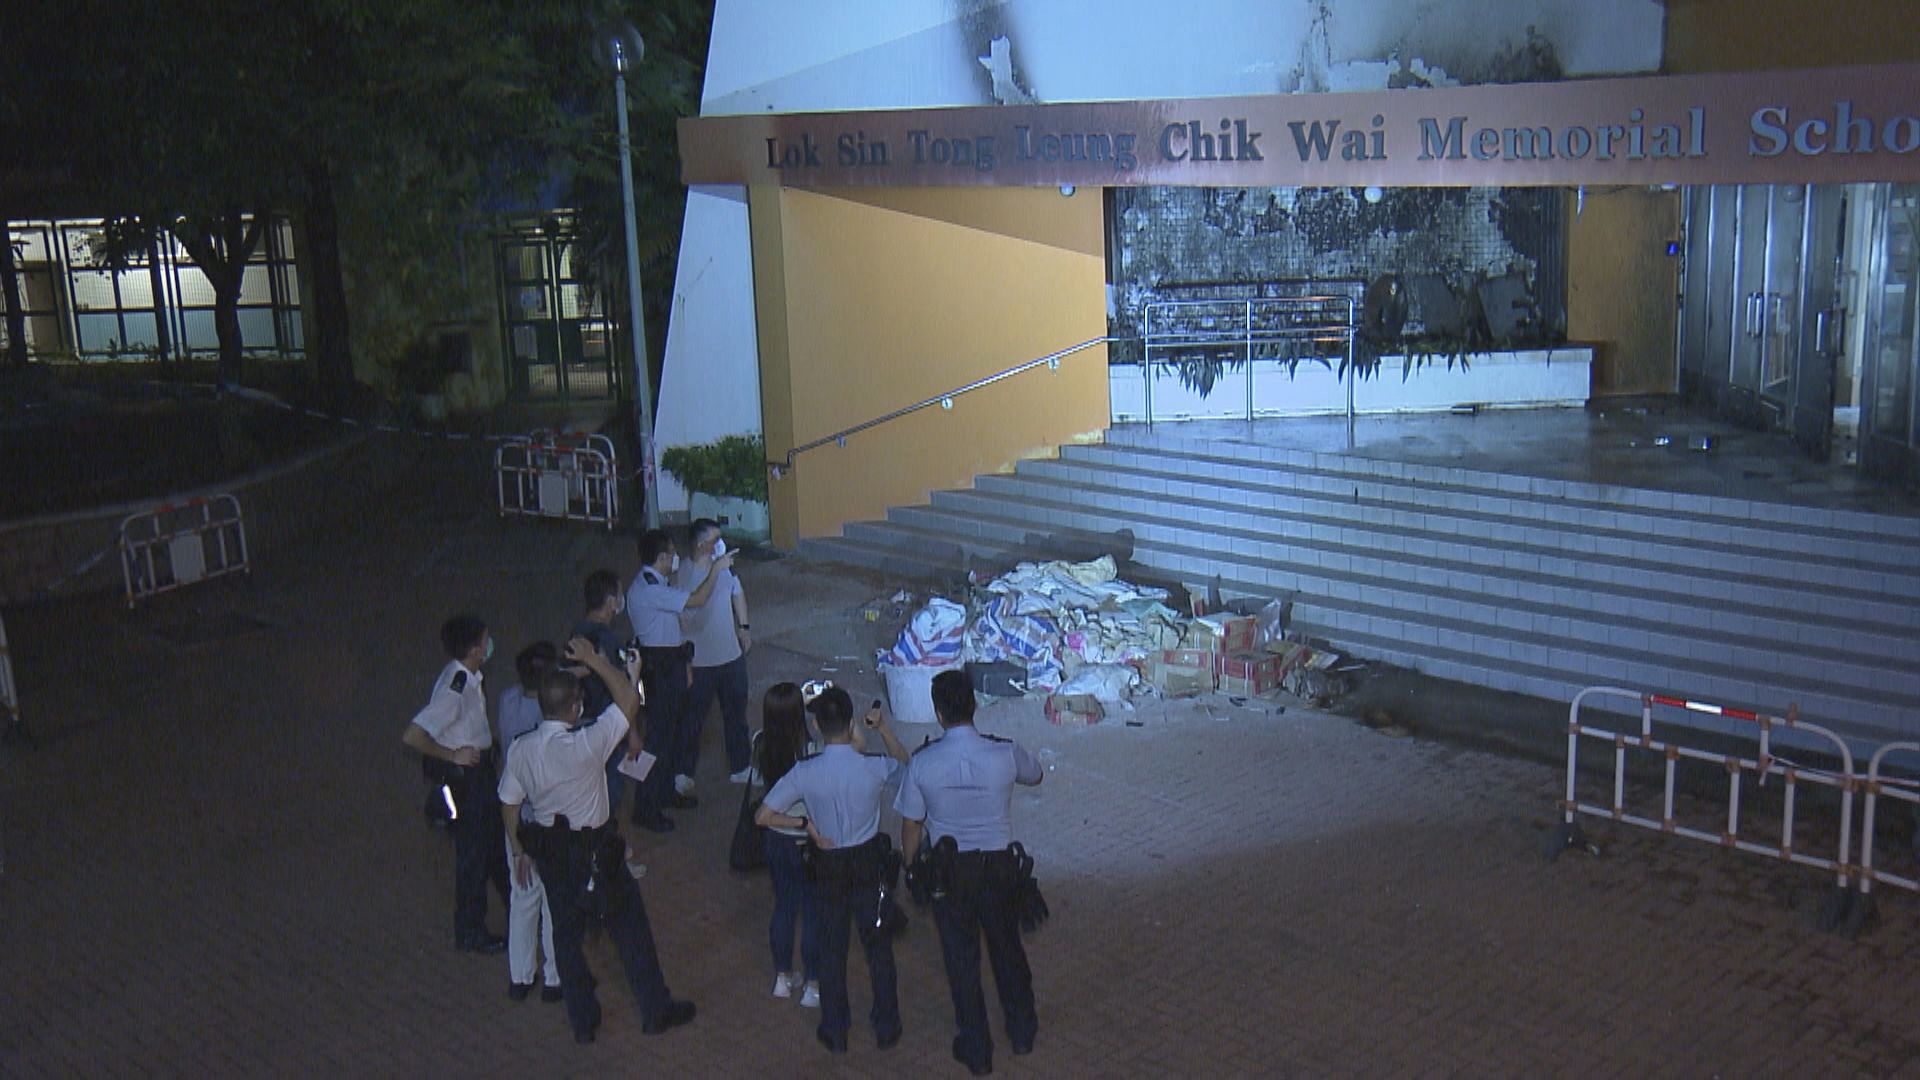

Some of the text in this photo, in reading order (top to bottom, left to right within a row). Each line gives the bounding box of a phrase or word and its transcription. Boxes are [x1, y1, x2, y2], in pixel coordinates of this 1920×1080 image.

[765, 132, 822, 169] Lok
[836, 130, 890, 167] Sin
[906, 129, 997, 171] Tong
[1013, 124, 1138, 171] Leung
[1159, 118, 1265, 162] Chik
[1287, 114, 1388, 162] Wai
[1416, 106, 1709, 161] Memorial
